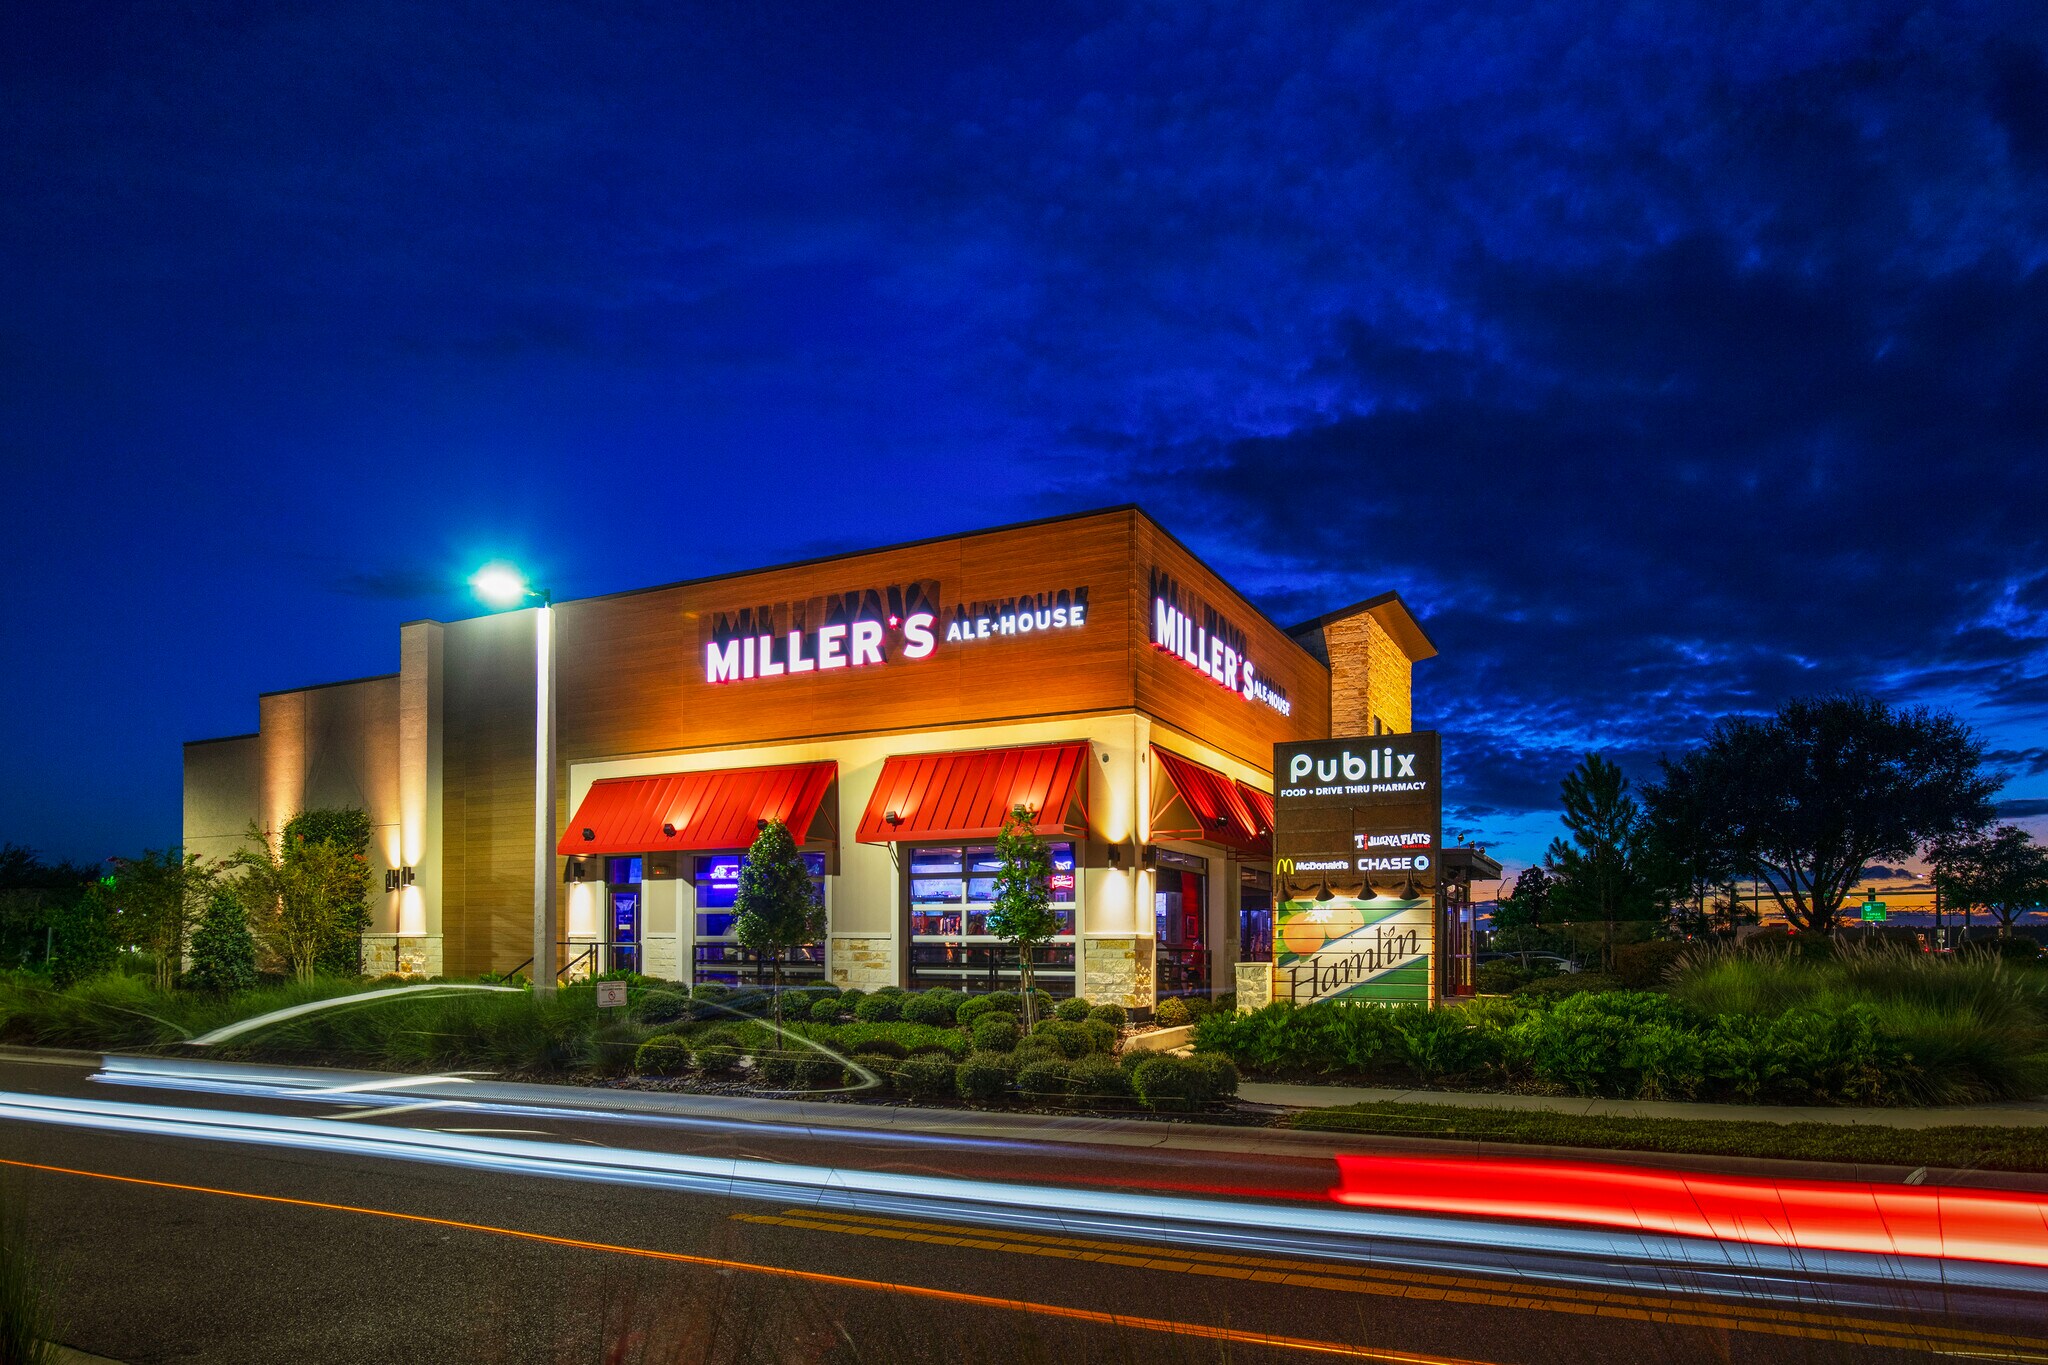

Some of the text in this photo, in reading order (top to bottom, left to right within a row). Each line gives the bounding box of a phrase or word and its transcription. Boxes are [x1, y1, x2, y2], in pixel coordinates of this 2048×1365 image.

[1290, 747, 1416, 784] Publix
[1280, 781, 1426, 797] FOOD DRIVE THRU PHARMACY
[1357, 857, 1412, 871] CHASE
[1287, 925, 1421, 1001] Hamlin
